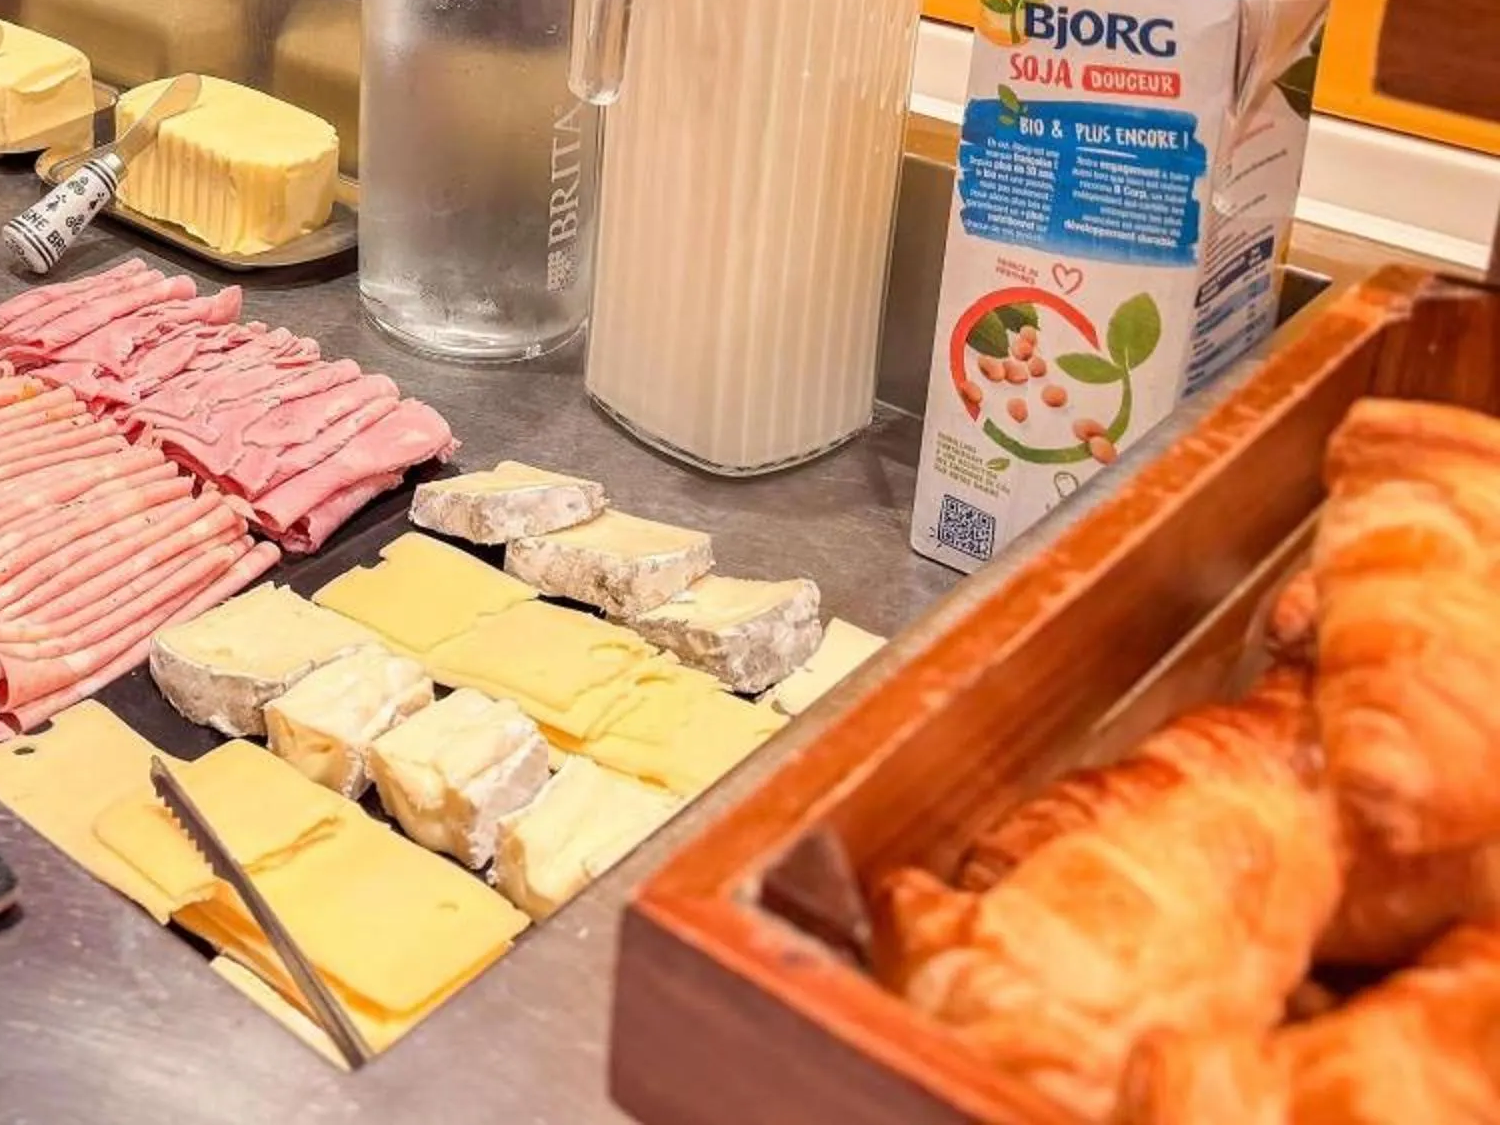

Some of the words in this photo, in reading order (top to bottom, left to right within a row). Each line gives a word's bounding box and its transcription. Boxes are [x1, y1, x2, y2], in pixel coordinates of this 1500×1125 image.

[1010, 53, 1073, 89] SOJA
[1091, 71, 1174, 94] DOUCEUR
[1020, 116, 1044, 137] BIO
[1051, 119, 1063, 139] &
[1075, 123, 1111, 143] PLUS
[1116, 128, 1178, 149] ENCORE
[549, 101, 583, 246] BRITA
